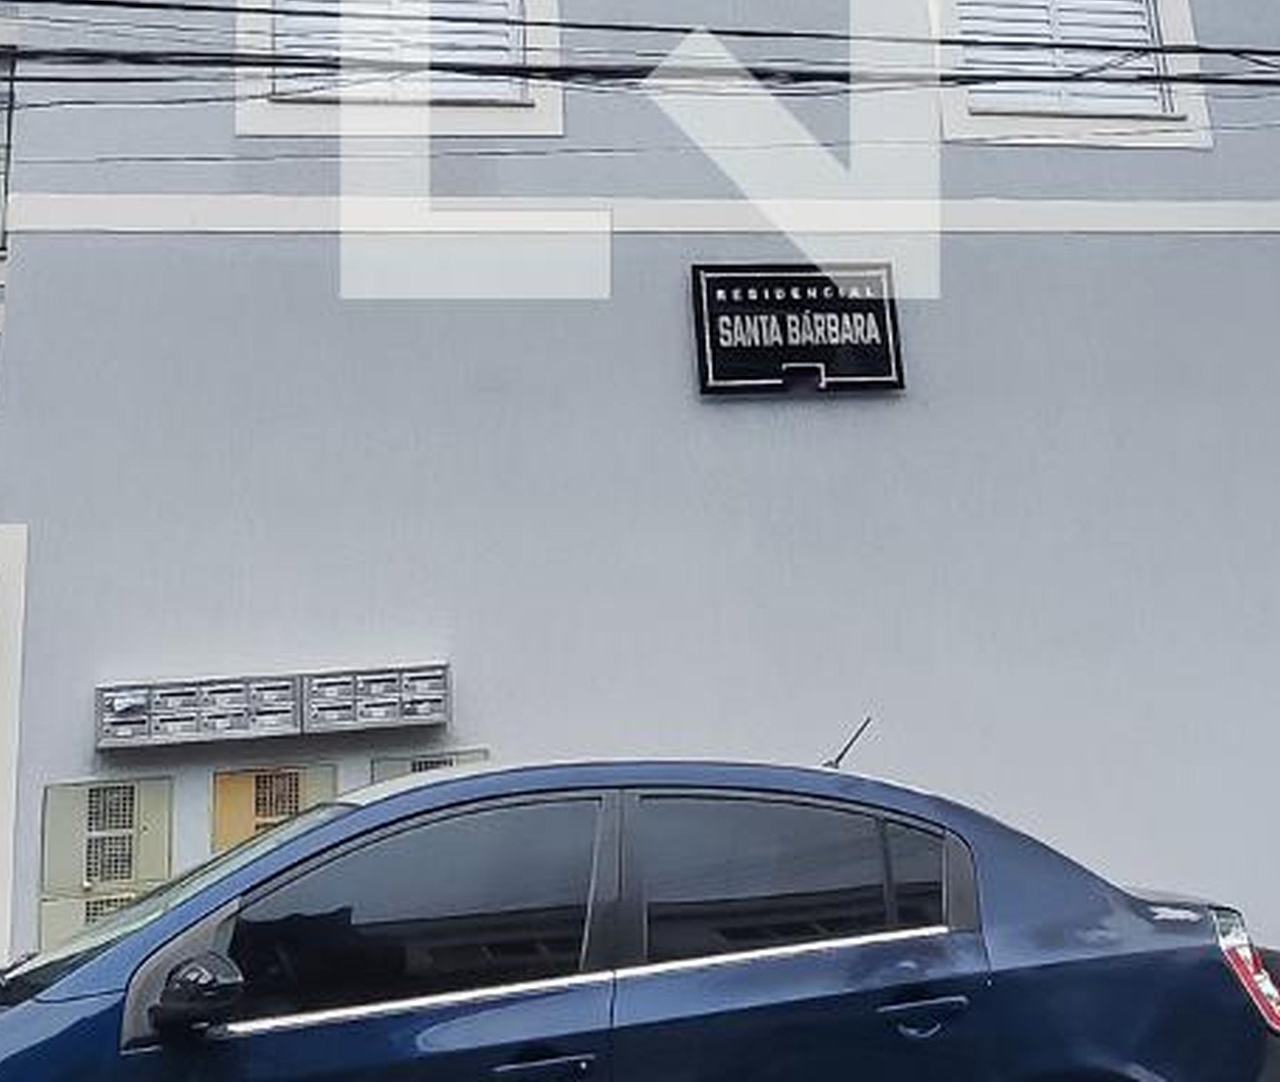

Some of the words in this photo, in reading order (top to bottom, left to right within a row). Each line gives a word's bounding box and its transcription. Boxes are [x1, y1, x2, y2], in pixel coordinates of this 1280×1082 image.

[716, 286, 876, 301] RESIDENCIAL
[719, 314, 784, 348] SANTA
[786, 308, 882, 346] BÁRBARA
